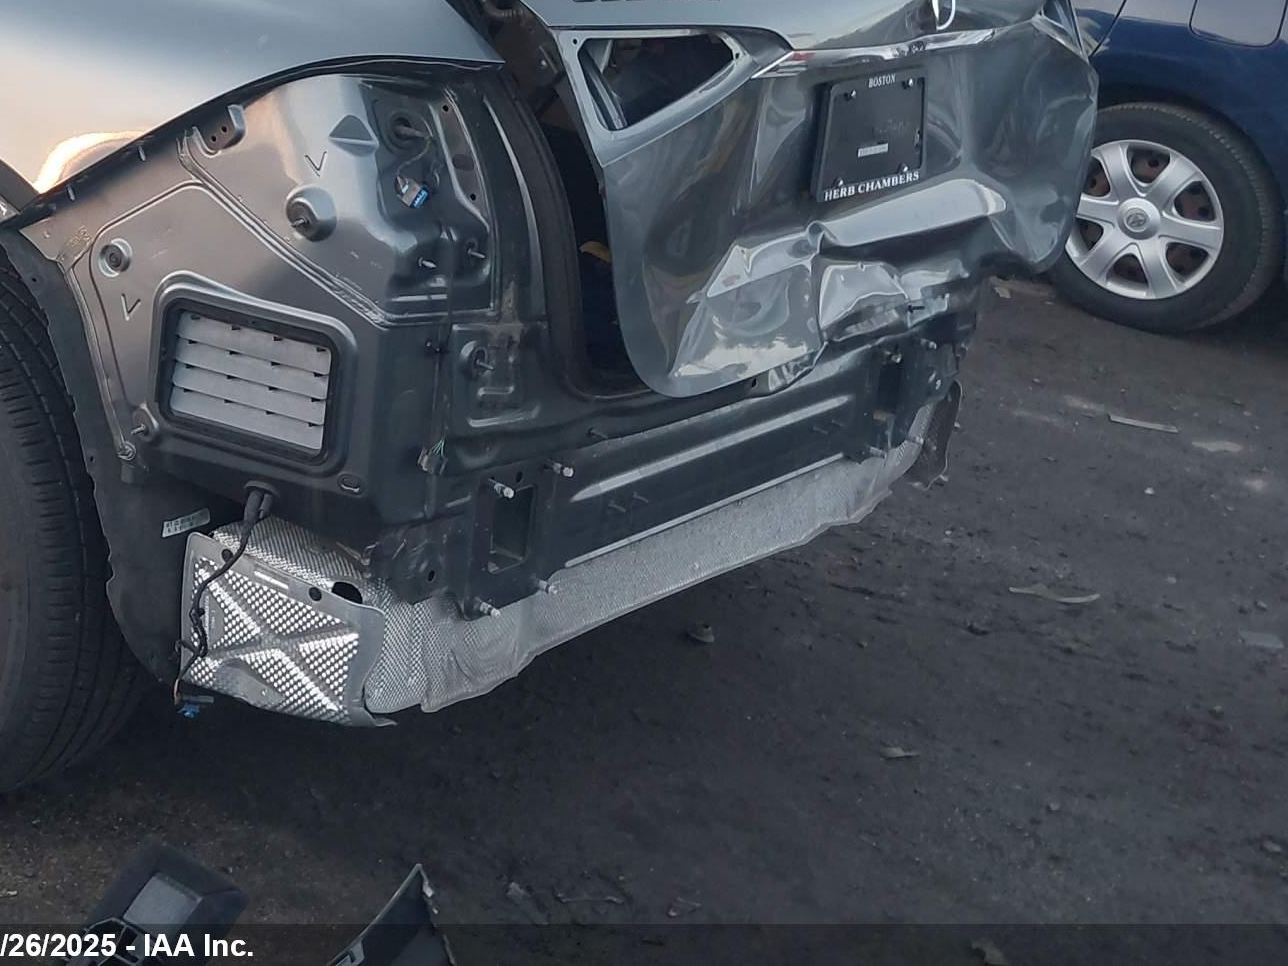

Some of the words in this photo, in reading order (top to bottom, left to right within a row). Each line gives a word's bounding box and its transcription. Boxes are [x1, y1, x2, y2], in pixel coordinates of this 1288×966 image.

[868, 73, 896, 89] BOSTON
[823, 185, 855, 202] HERB
[857, 171, 920, 194] CHAMBERS
